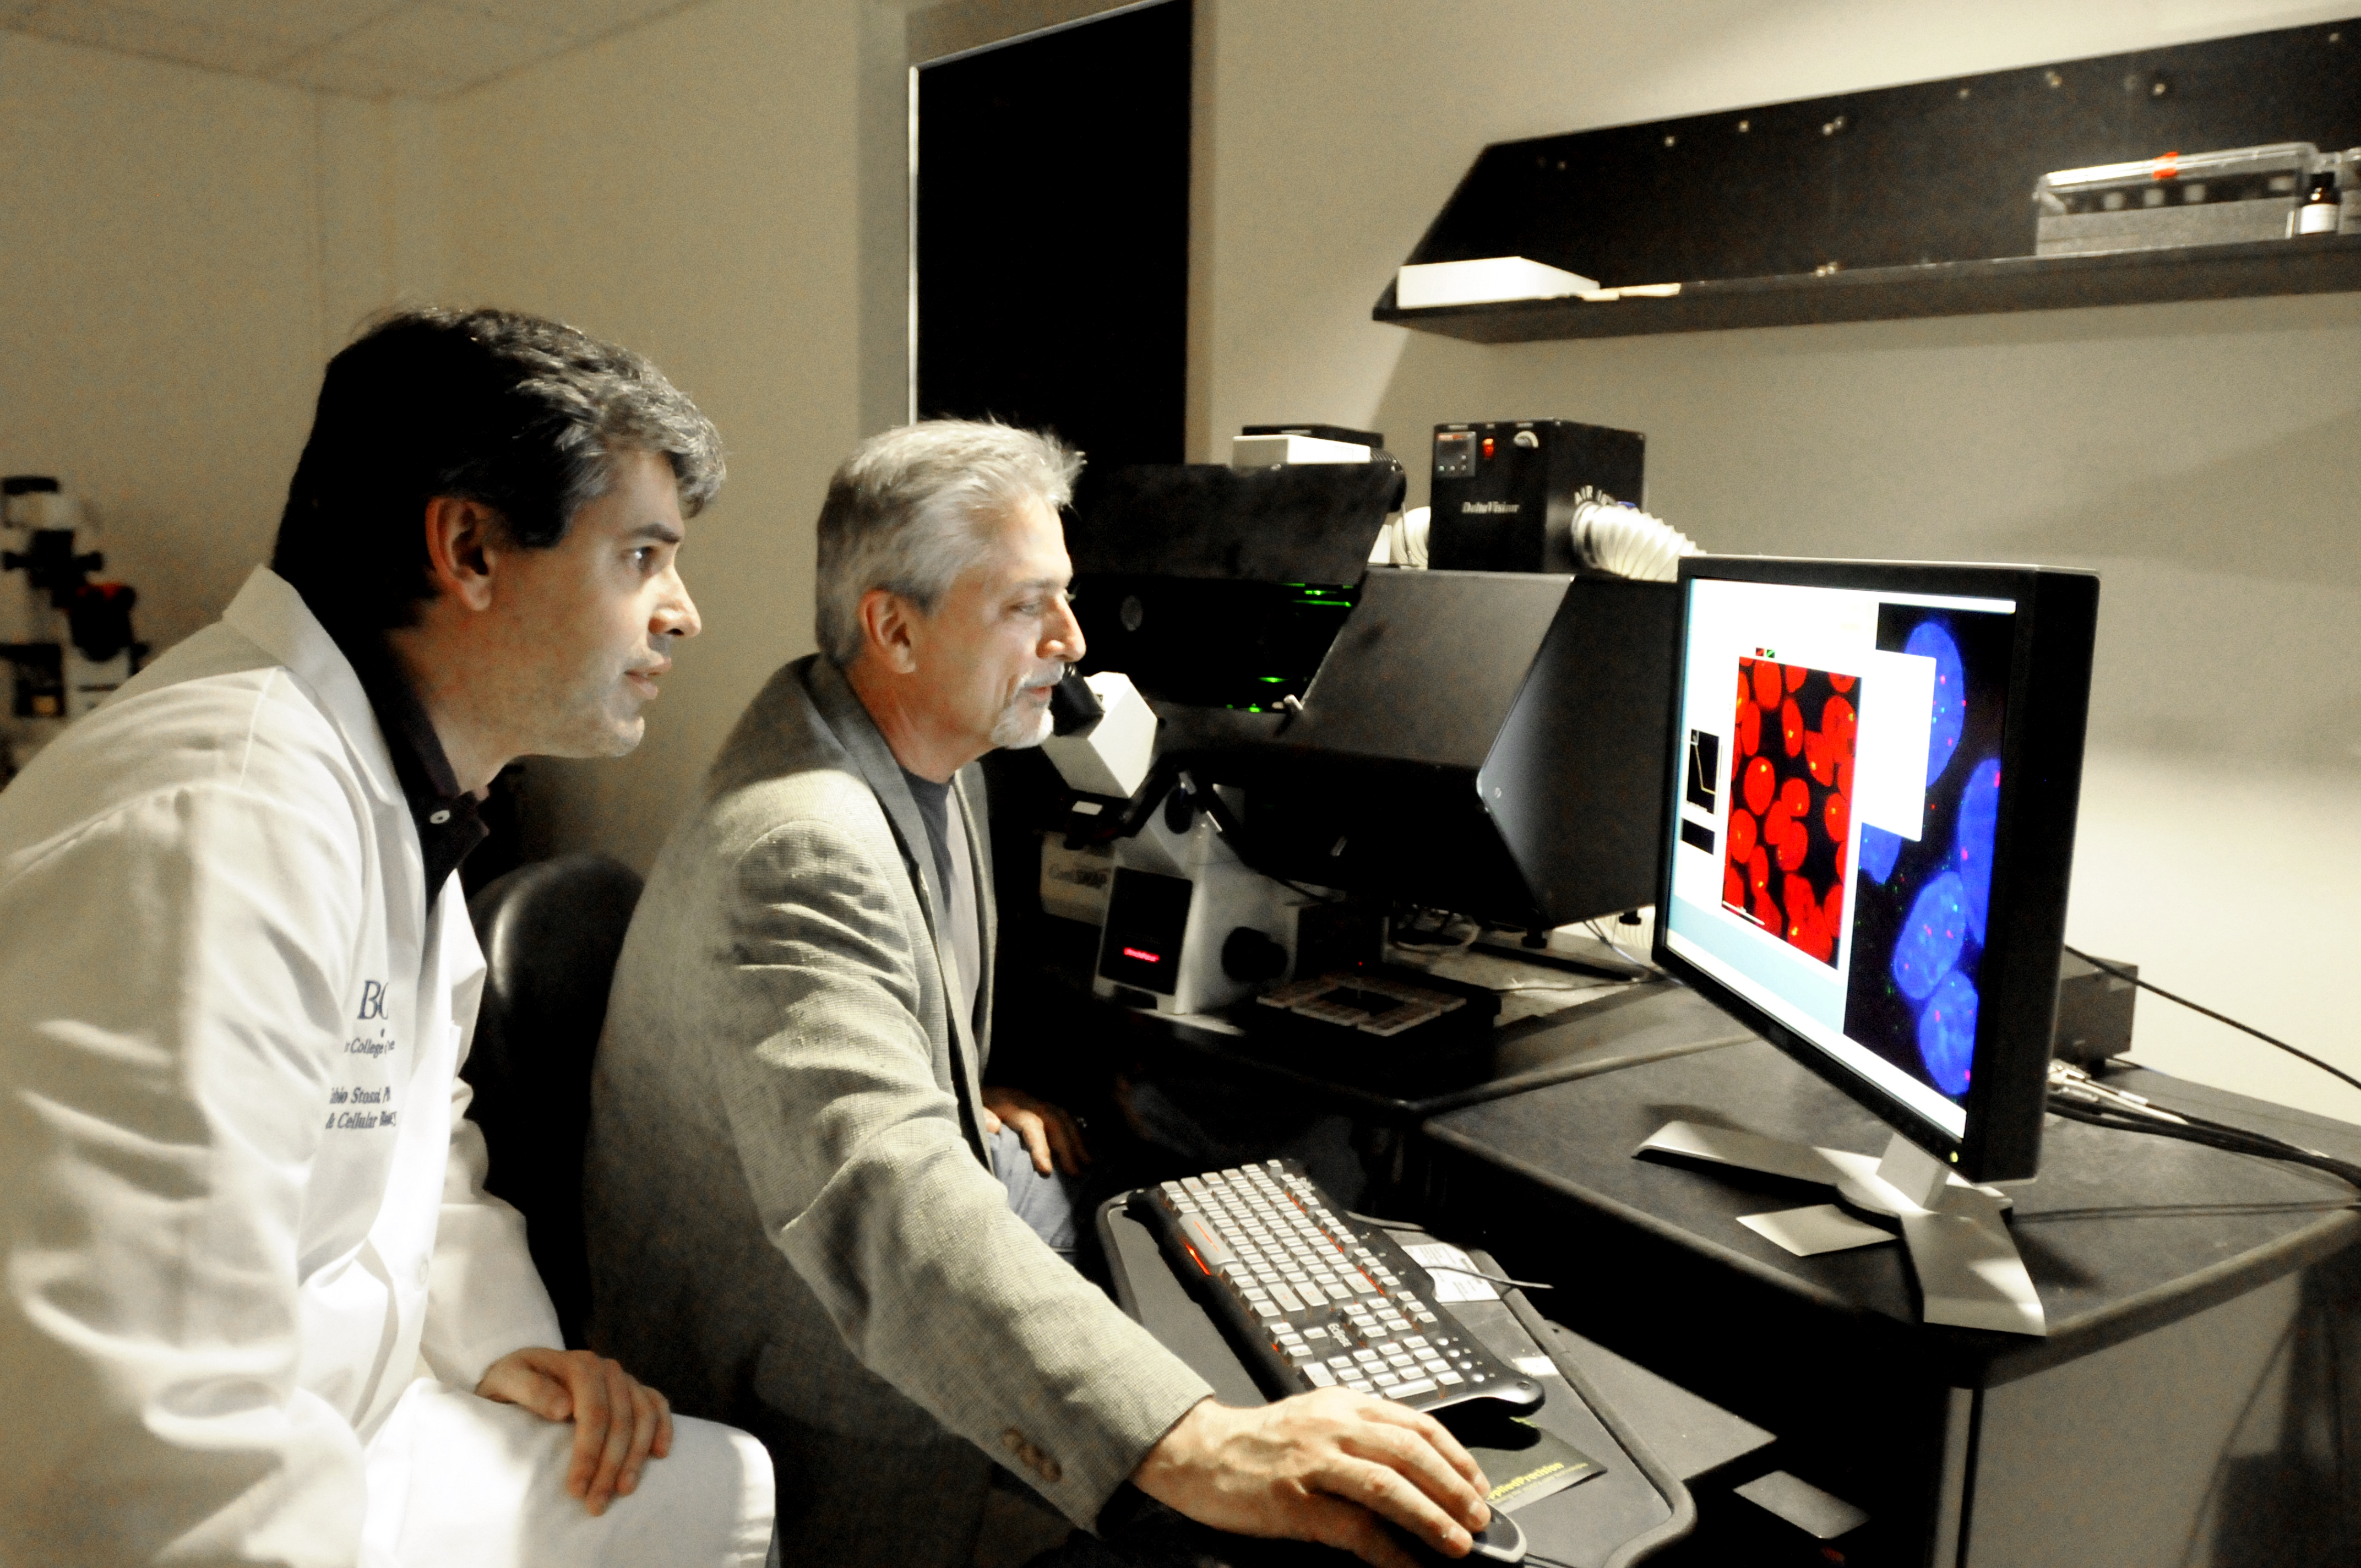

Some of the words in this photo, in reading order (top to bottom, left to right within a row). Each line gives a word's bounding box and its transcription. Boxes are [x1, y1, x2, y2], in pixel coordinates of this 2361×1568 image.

[1574, 485, 1593, 506] AIR
[350, 1037, 384, 1058] College
[338, 1111, 378, 1129] Cellular
[1487, 1462, 1565, 1501] ppliedPrecision
